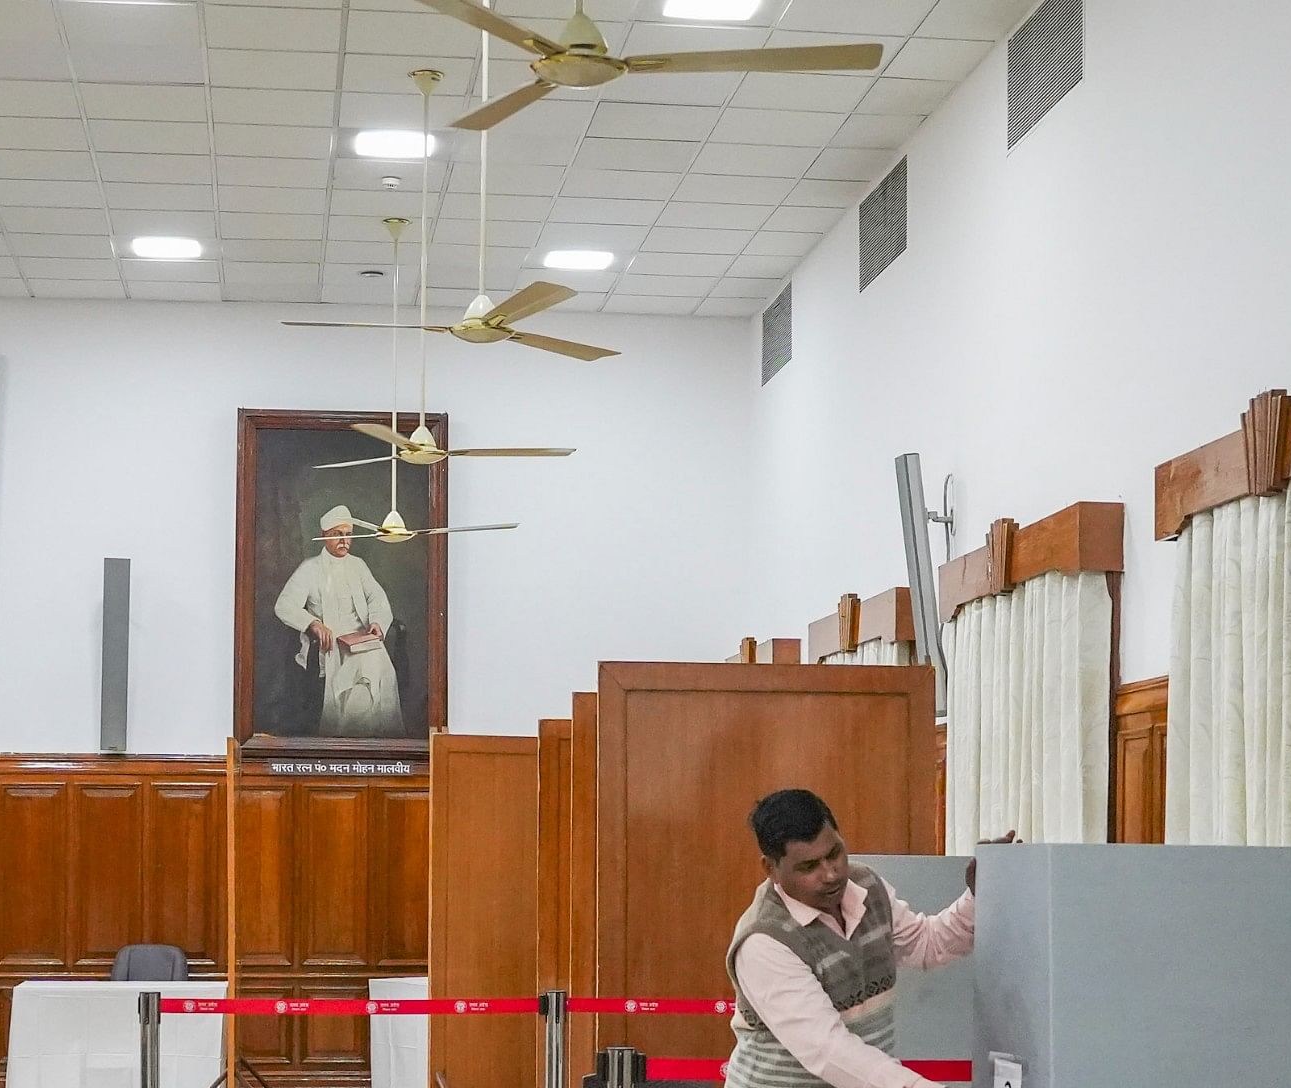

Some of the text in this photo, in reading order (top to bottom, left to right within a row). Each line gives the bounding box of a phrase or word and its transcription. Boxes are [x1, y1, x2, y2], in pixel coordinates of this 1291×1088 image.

[271, 763, 294, 773] भारत
[295, 763, 312, 773] रत्न
[329, 763, 350, 773] मदन
[351, 760, 375, 774] मोहन
[376, 761, 410, 774] मालवीय
